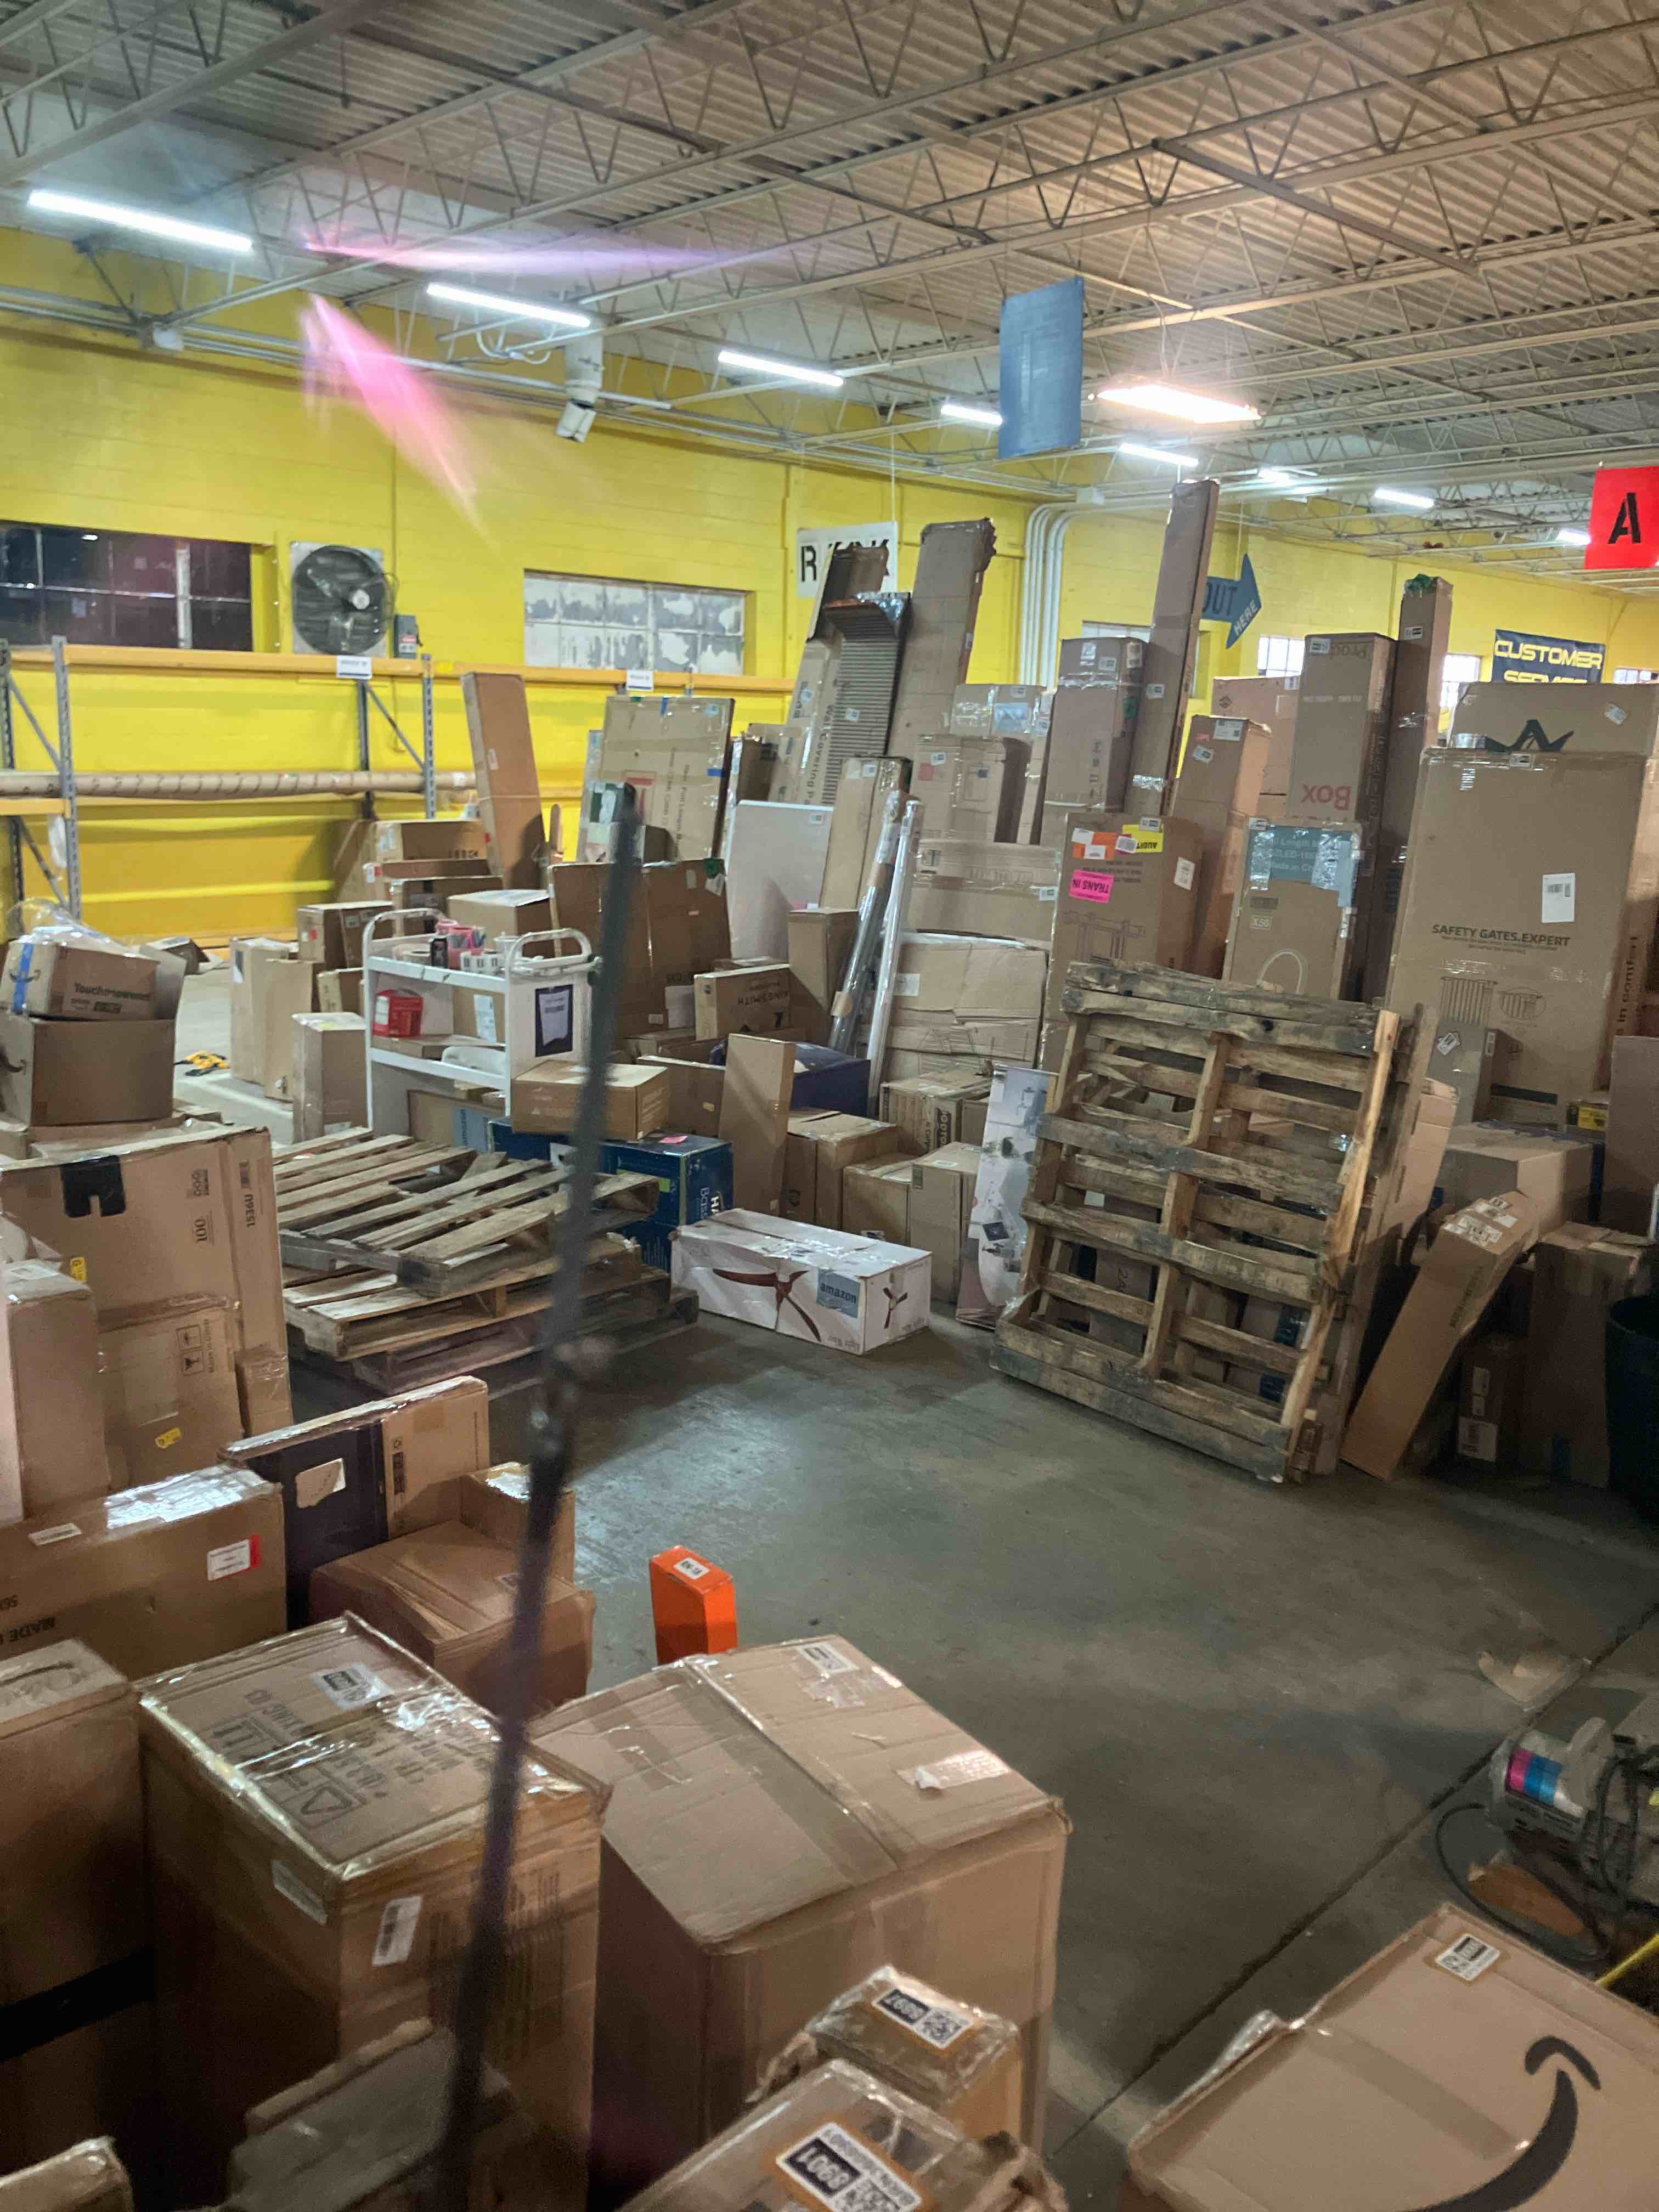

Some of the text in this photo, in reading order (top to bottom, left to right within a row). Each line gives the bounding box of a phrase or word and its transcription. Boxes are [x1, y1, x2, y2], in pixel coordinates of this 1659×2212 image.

[1608, 492, 1641, 544] A
[1234, 599, 1258, 636] HERE
[1494, 640, 1602, 669] CUSTOMER
[1300, 781, 1352, 811] Box
[1073, 879, 1109, 894] TRANS IN
[1432, 924, 1476, 938] SAFETY
[820, 1283, 856, 1304] amazon
